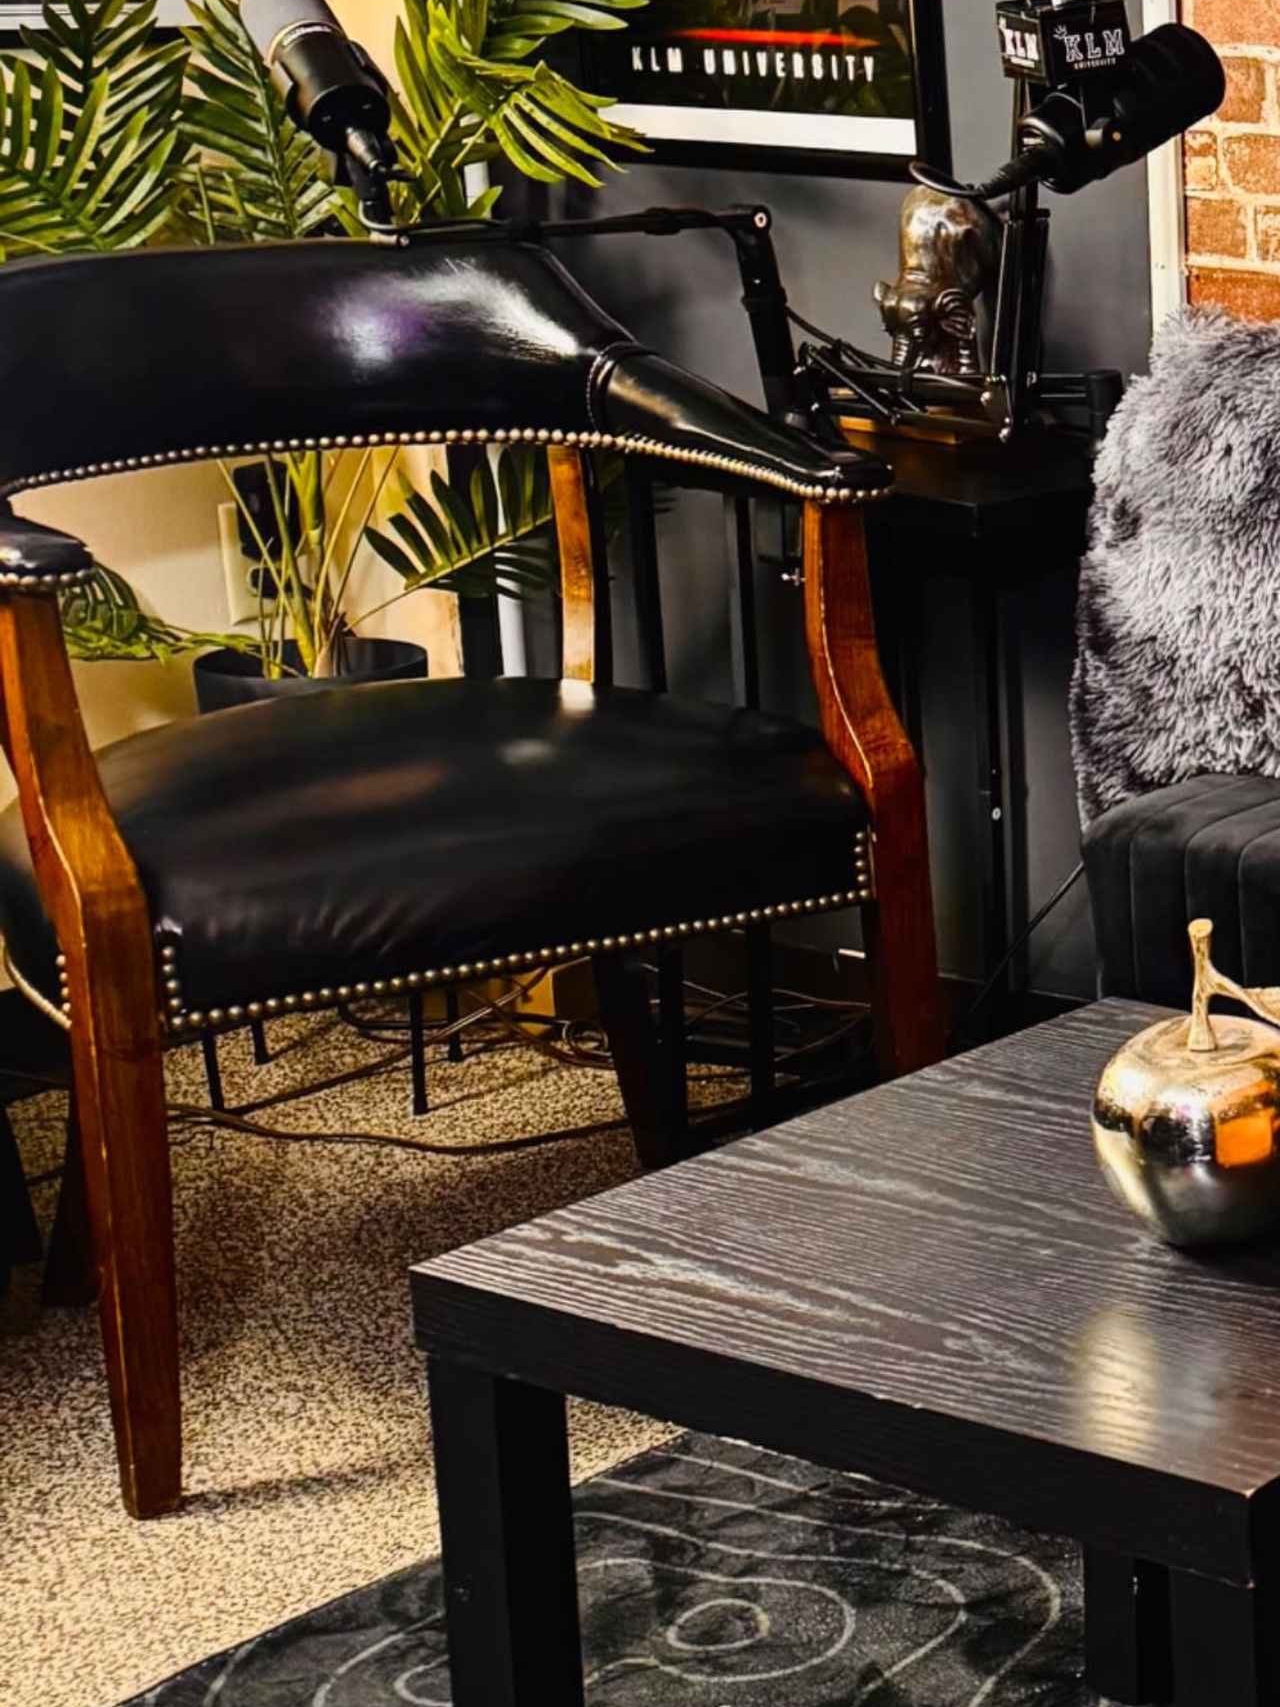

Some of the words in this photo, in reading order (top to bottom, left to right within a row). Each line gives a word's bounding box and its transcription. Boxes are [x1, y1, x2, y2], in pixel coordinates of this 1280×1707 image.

[1064, 27, 1125, 62] KLM
[631, 46, 684, 73] KLM
[702, 48, 876, 83] UNIVERSITY
